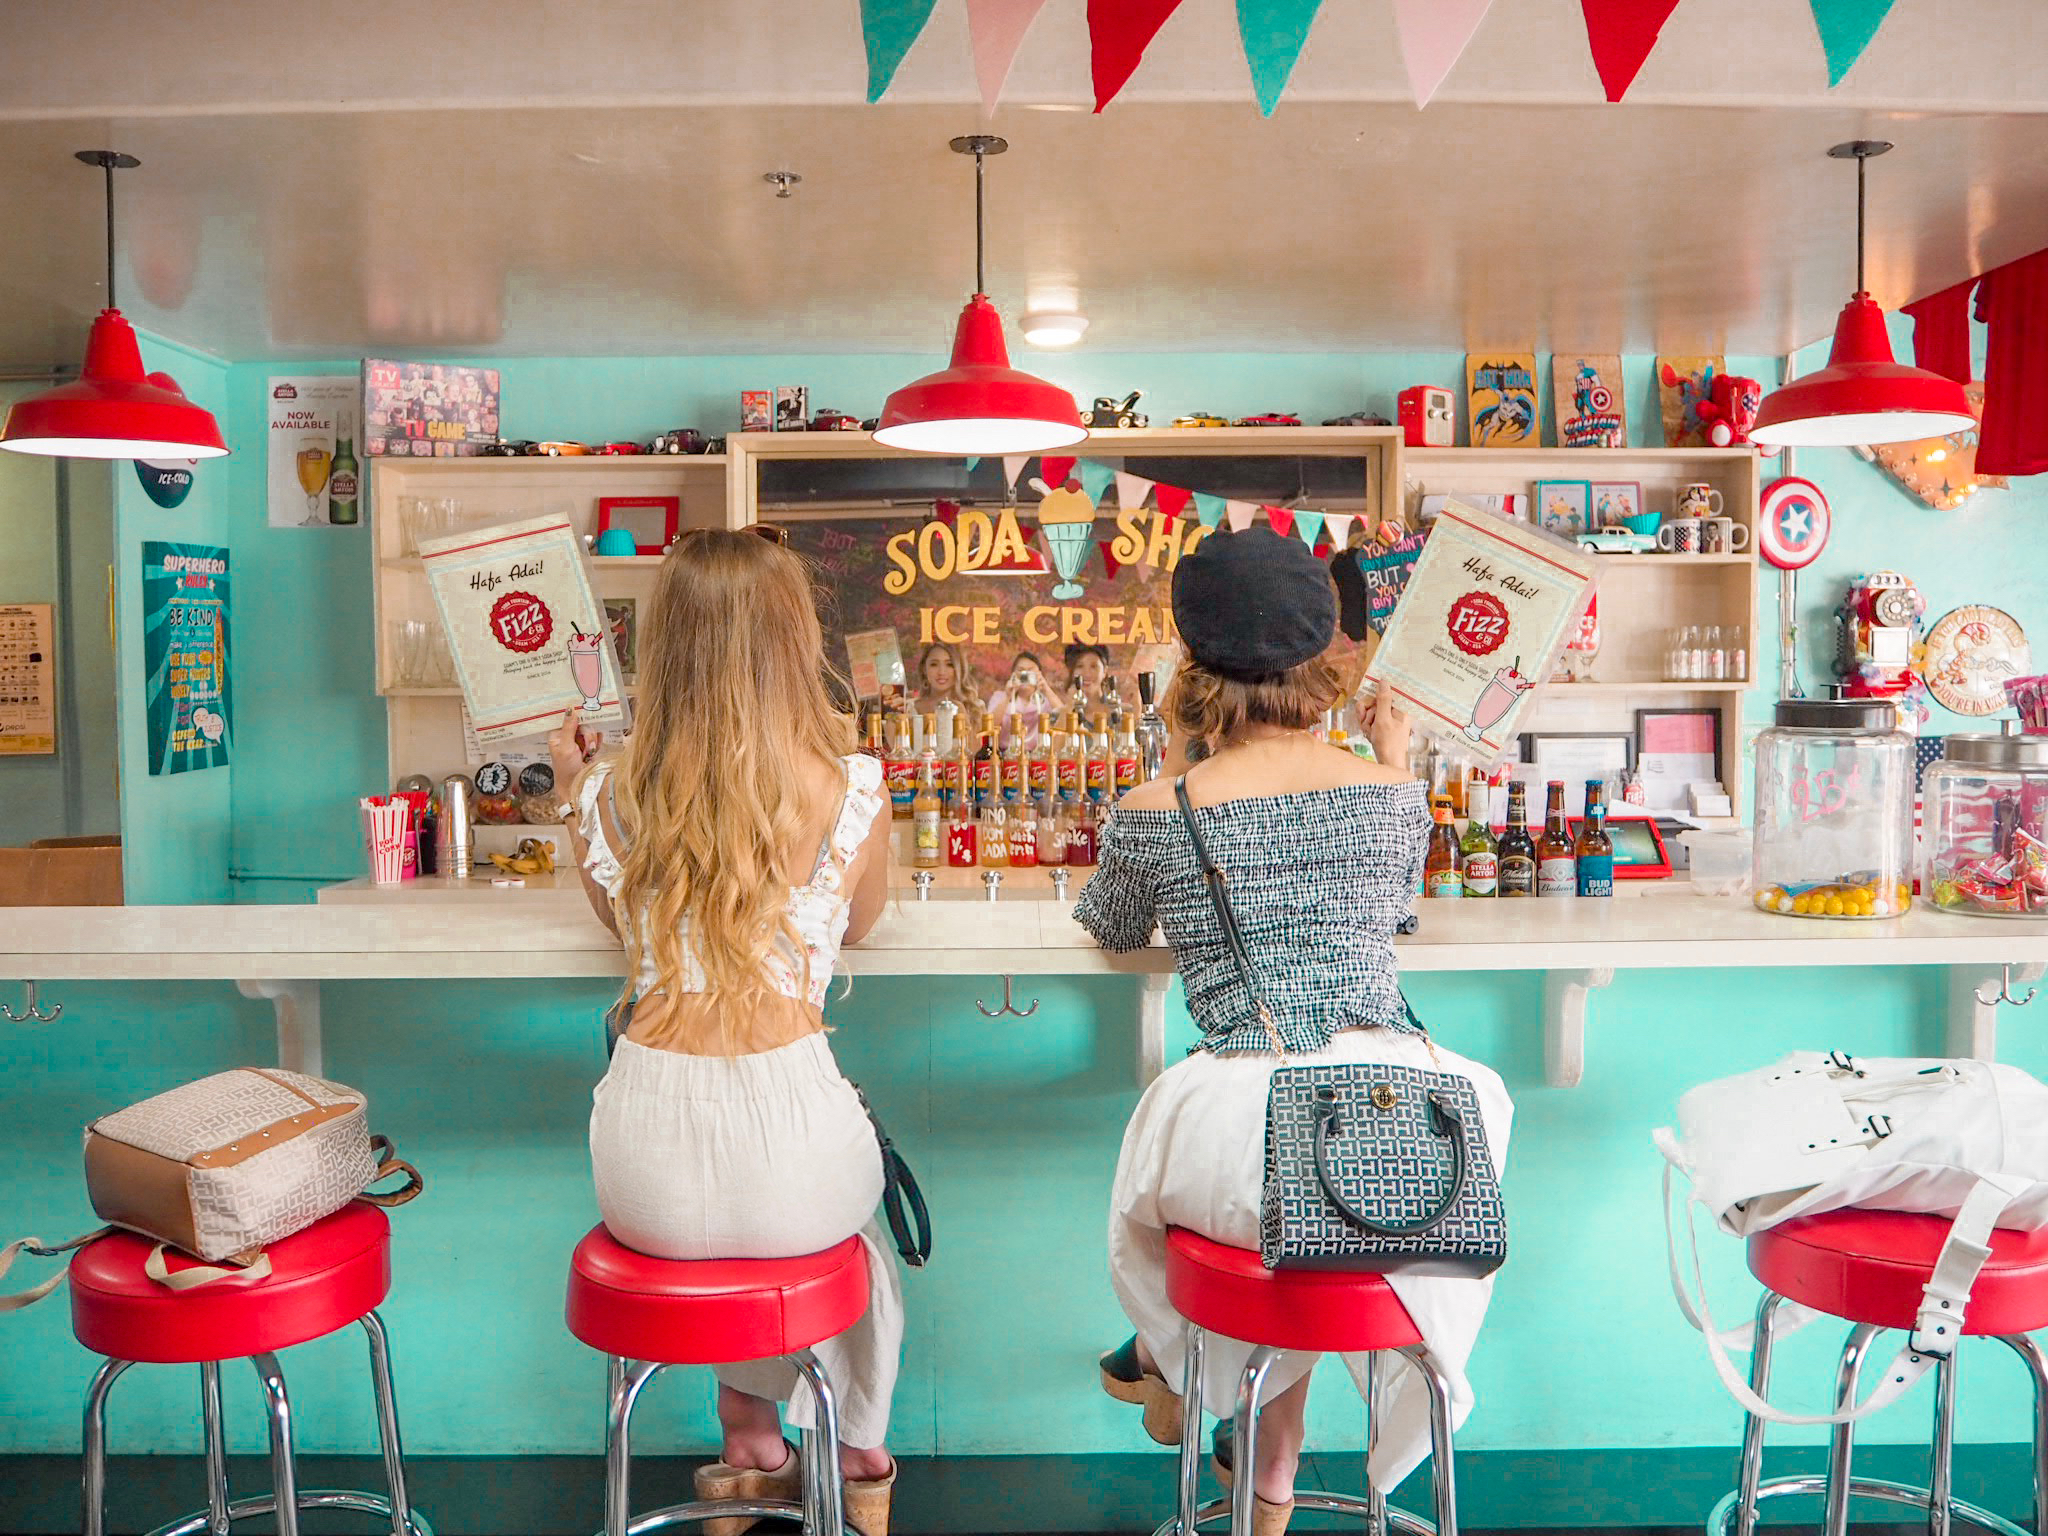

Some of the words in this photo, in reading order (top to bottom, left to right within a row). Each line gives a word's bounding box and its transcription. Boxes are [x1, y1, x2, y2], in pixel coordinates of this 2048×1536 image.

[375, 369, 397, 381] TV
[288, 412, 315, 420] NOW
[272, 421, 331, 429] AVAILABLE
[405, 420, 425, 438] TV
[428, 421, 466, 440] GAME
[158, 473, 190, 485] ICE-COLD
[883, 508, 1031, 595] SODA
[164, 554, 226, 574] SUPERHERO
[469, 571, 502, 592] Hafa
[508, 560, 543, 581] Adai!
[1366, 565, 1400, 589] BUT
[1462, 557, 1495, 581] Hafa
[1500, 576, 1540, 600] Adai!
[1376, 584, 1397, 598] YOU
[1372, 596, 1392, 609] BUY
[170, 608, 183, 626] BE
[188, 608, 213, 626] KIND
[919, 606, 1001, 644] ICE
[888, 764, 914, 779] Torani
[379, 837, 394, 847] POP
[1589, 880, 1611, 888] BUD
[1585, 887, 1613, 896] LIGHT
